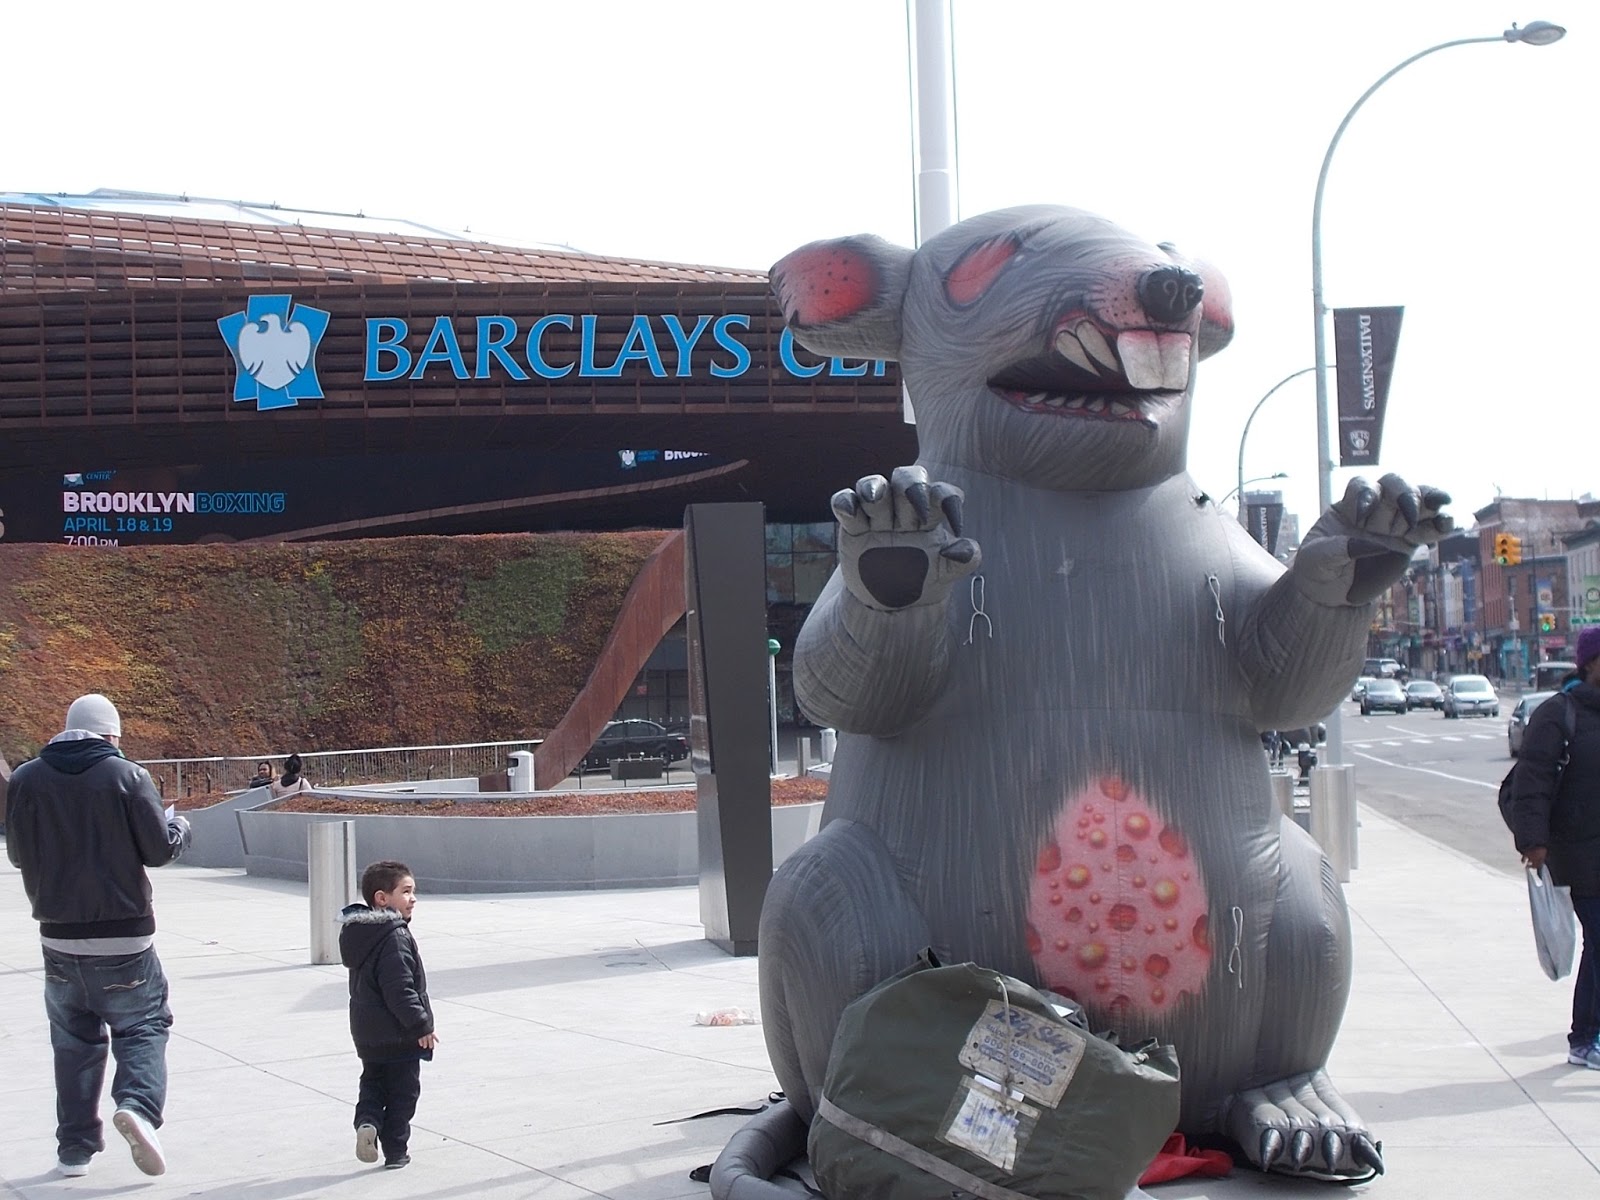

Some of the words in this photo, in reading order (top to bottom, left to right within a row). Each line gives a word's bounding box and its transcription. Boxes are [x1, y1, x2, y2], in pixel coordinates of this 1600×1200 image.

[364, 313, 752, 381] BARCLAYS
[1360, 314, 1372, 360] DAILY
[1362, 362, 1375, 410] NEWS
[63, 491, 195, 513] BROOKLYN
[196, 492, 285, 513] BOXING
[63, 517, 112, 532] APRIL
[63, 535, 98, 547] 7:00
[100, 538, 119, 547] PM
[994, 1008, 1034, 1037] Big
